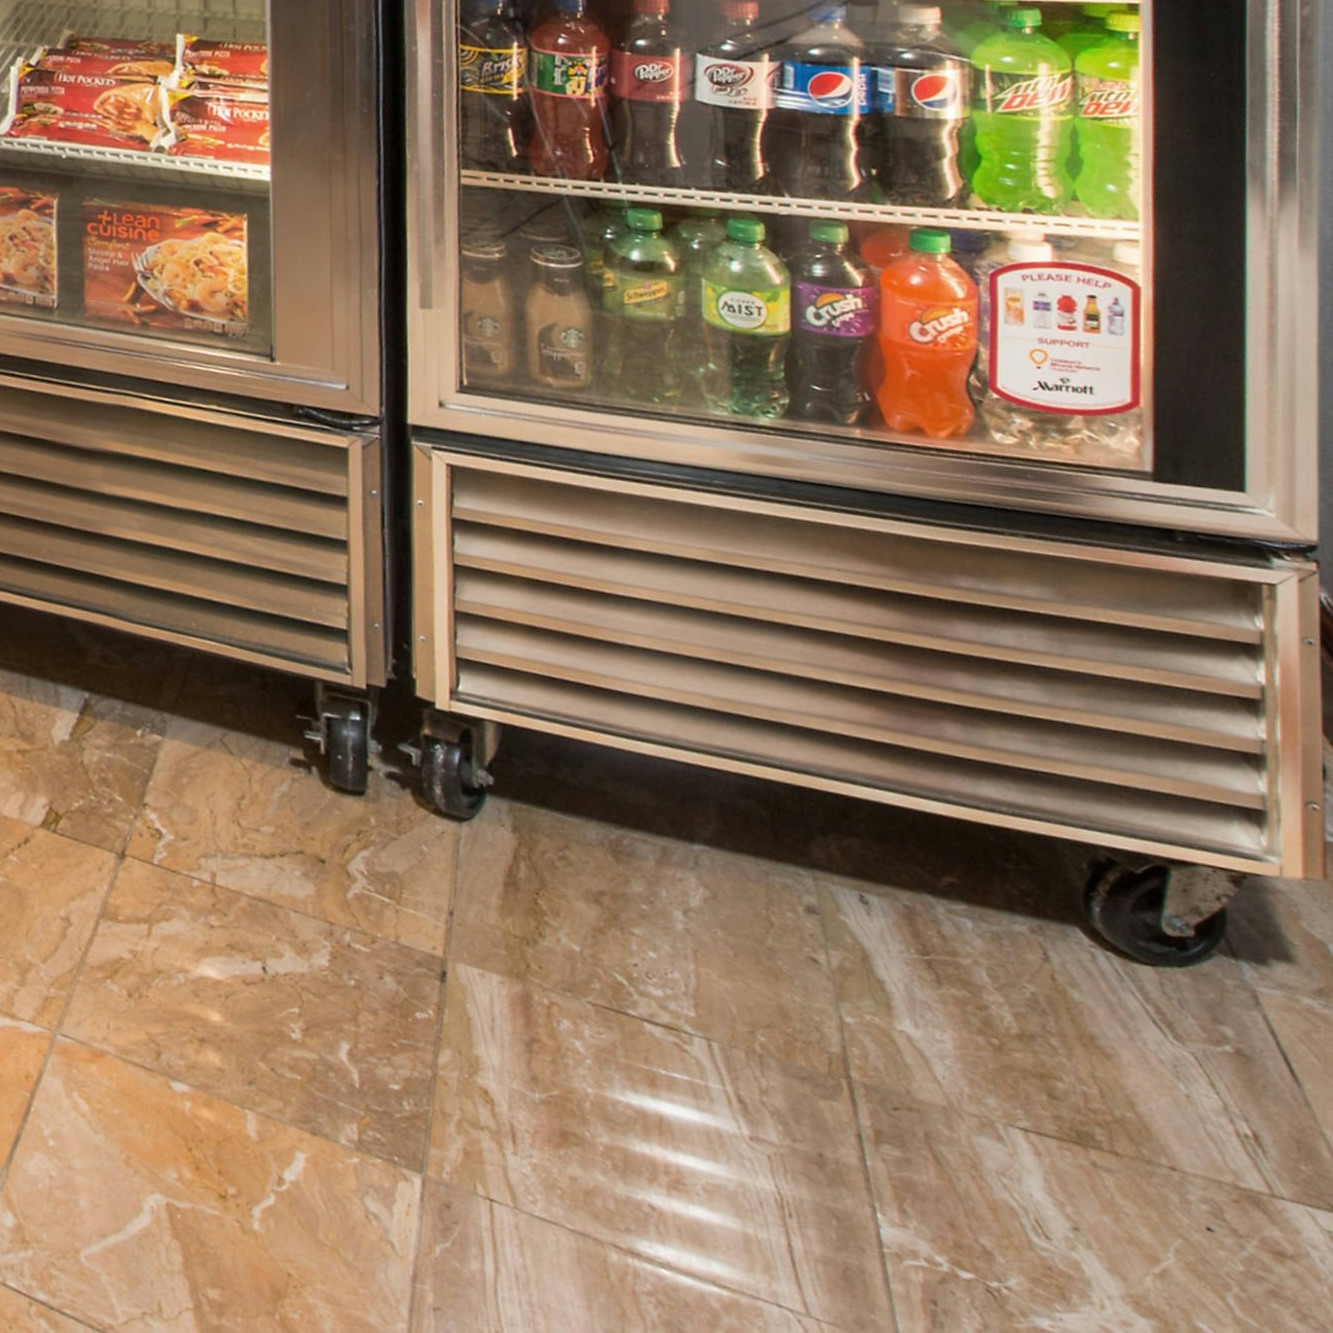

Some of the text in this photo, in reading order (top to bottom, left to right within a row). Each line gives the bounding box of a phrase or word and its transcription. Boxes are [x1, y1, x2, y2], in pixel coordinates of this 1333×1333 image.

[635, 64, 674, 81] Pepper
[712, 68, 746, 85] Pepper
[76, 75, 117, 88] POCKETS
[113, 212, 161, 229] Lean
[86, 221, 161, 243] cuisine
[87, 247, 117, 260] Shrimp
[87, 255, 130, 268] Angel Hair
[87, 262, 110, 272] Pasta
[1020, 273, 1113, 289] PLEASE HELP
[720, 301, 763, 317] MIST
[806, 294, 864, 328] Crush
[908, 308, 970, 344] Crush
[1036, 337, 1091, 349] SUPPORT
[1032, 379, 1096, 396] Marriott
